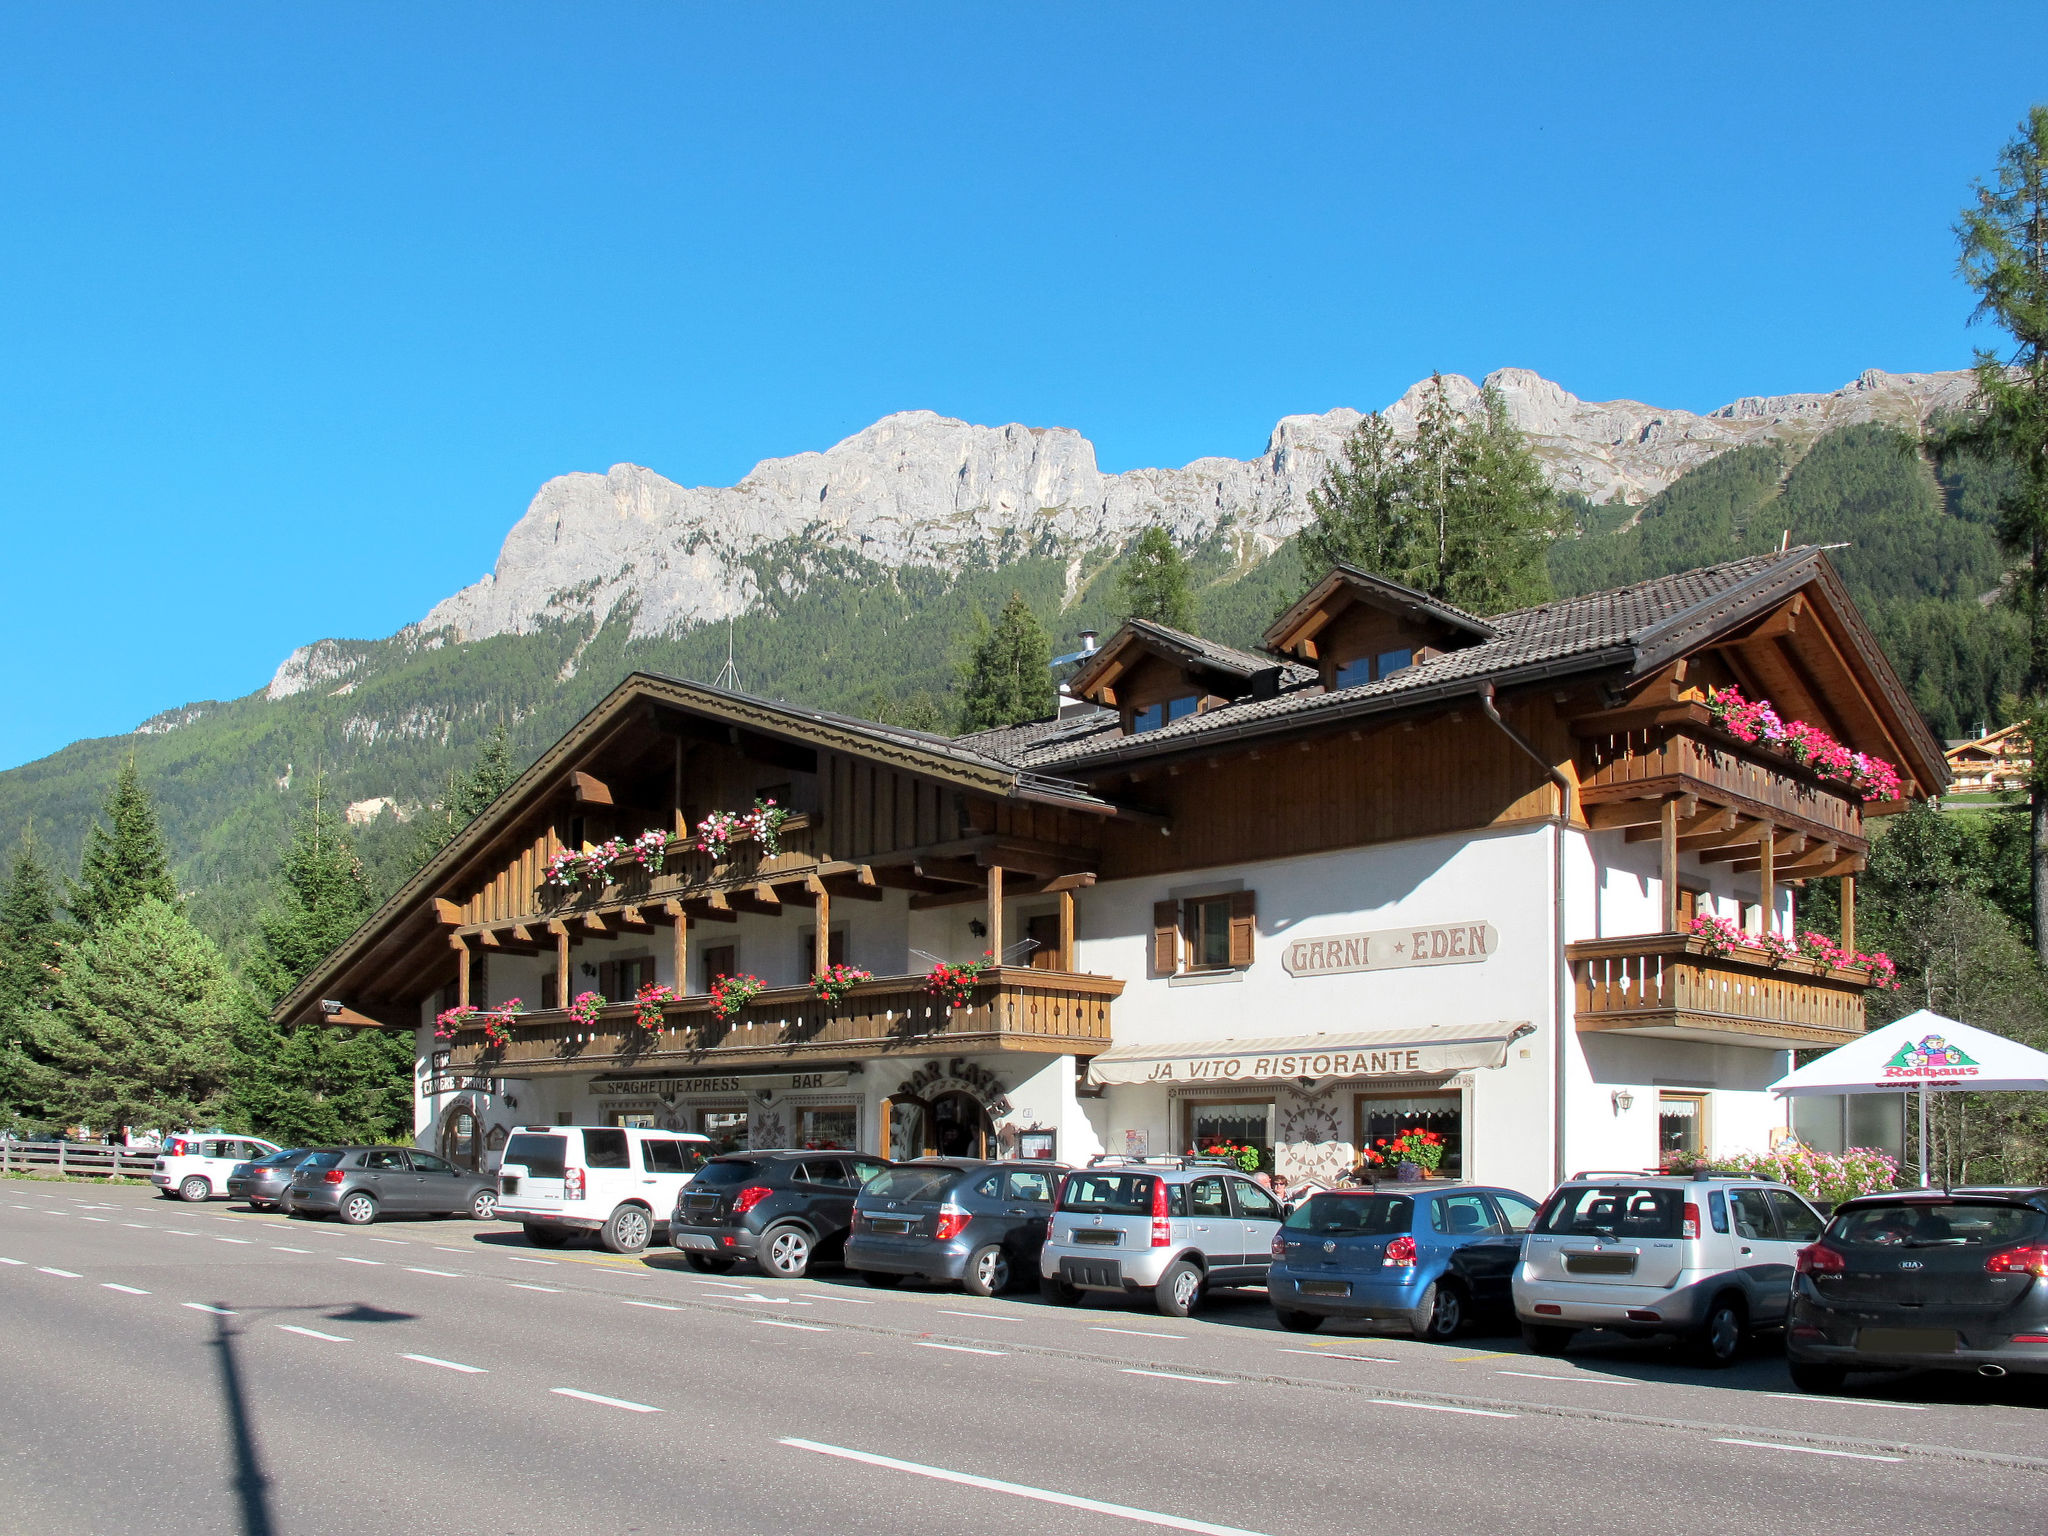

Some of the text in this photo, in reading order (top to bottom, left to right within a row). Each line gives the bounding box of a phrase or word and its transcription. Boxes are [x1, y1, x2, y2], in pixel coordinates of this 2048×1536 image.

[1291, 925, 1487, 971] GARNI EDEN
[1189, 1059, 1241, 1078] VITO
[1254, 1050, 1420, 1076] RISTORANTE
[1882, 1066, 1980, 1078] Rothaus
[423, 1076, 455, 1095] CAMERE
[461, 1076, 493, 1091] ZIMMER
[792, 1073, 823, 1089] BAR
